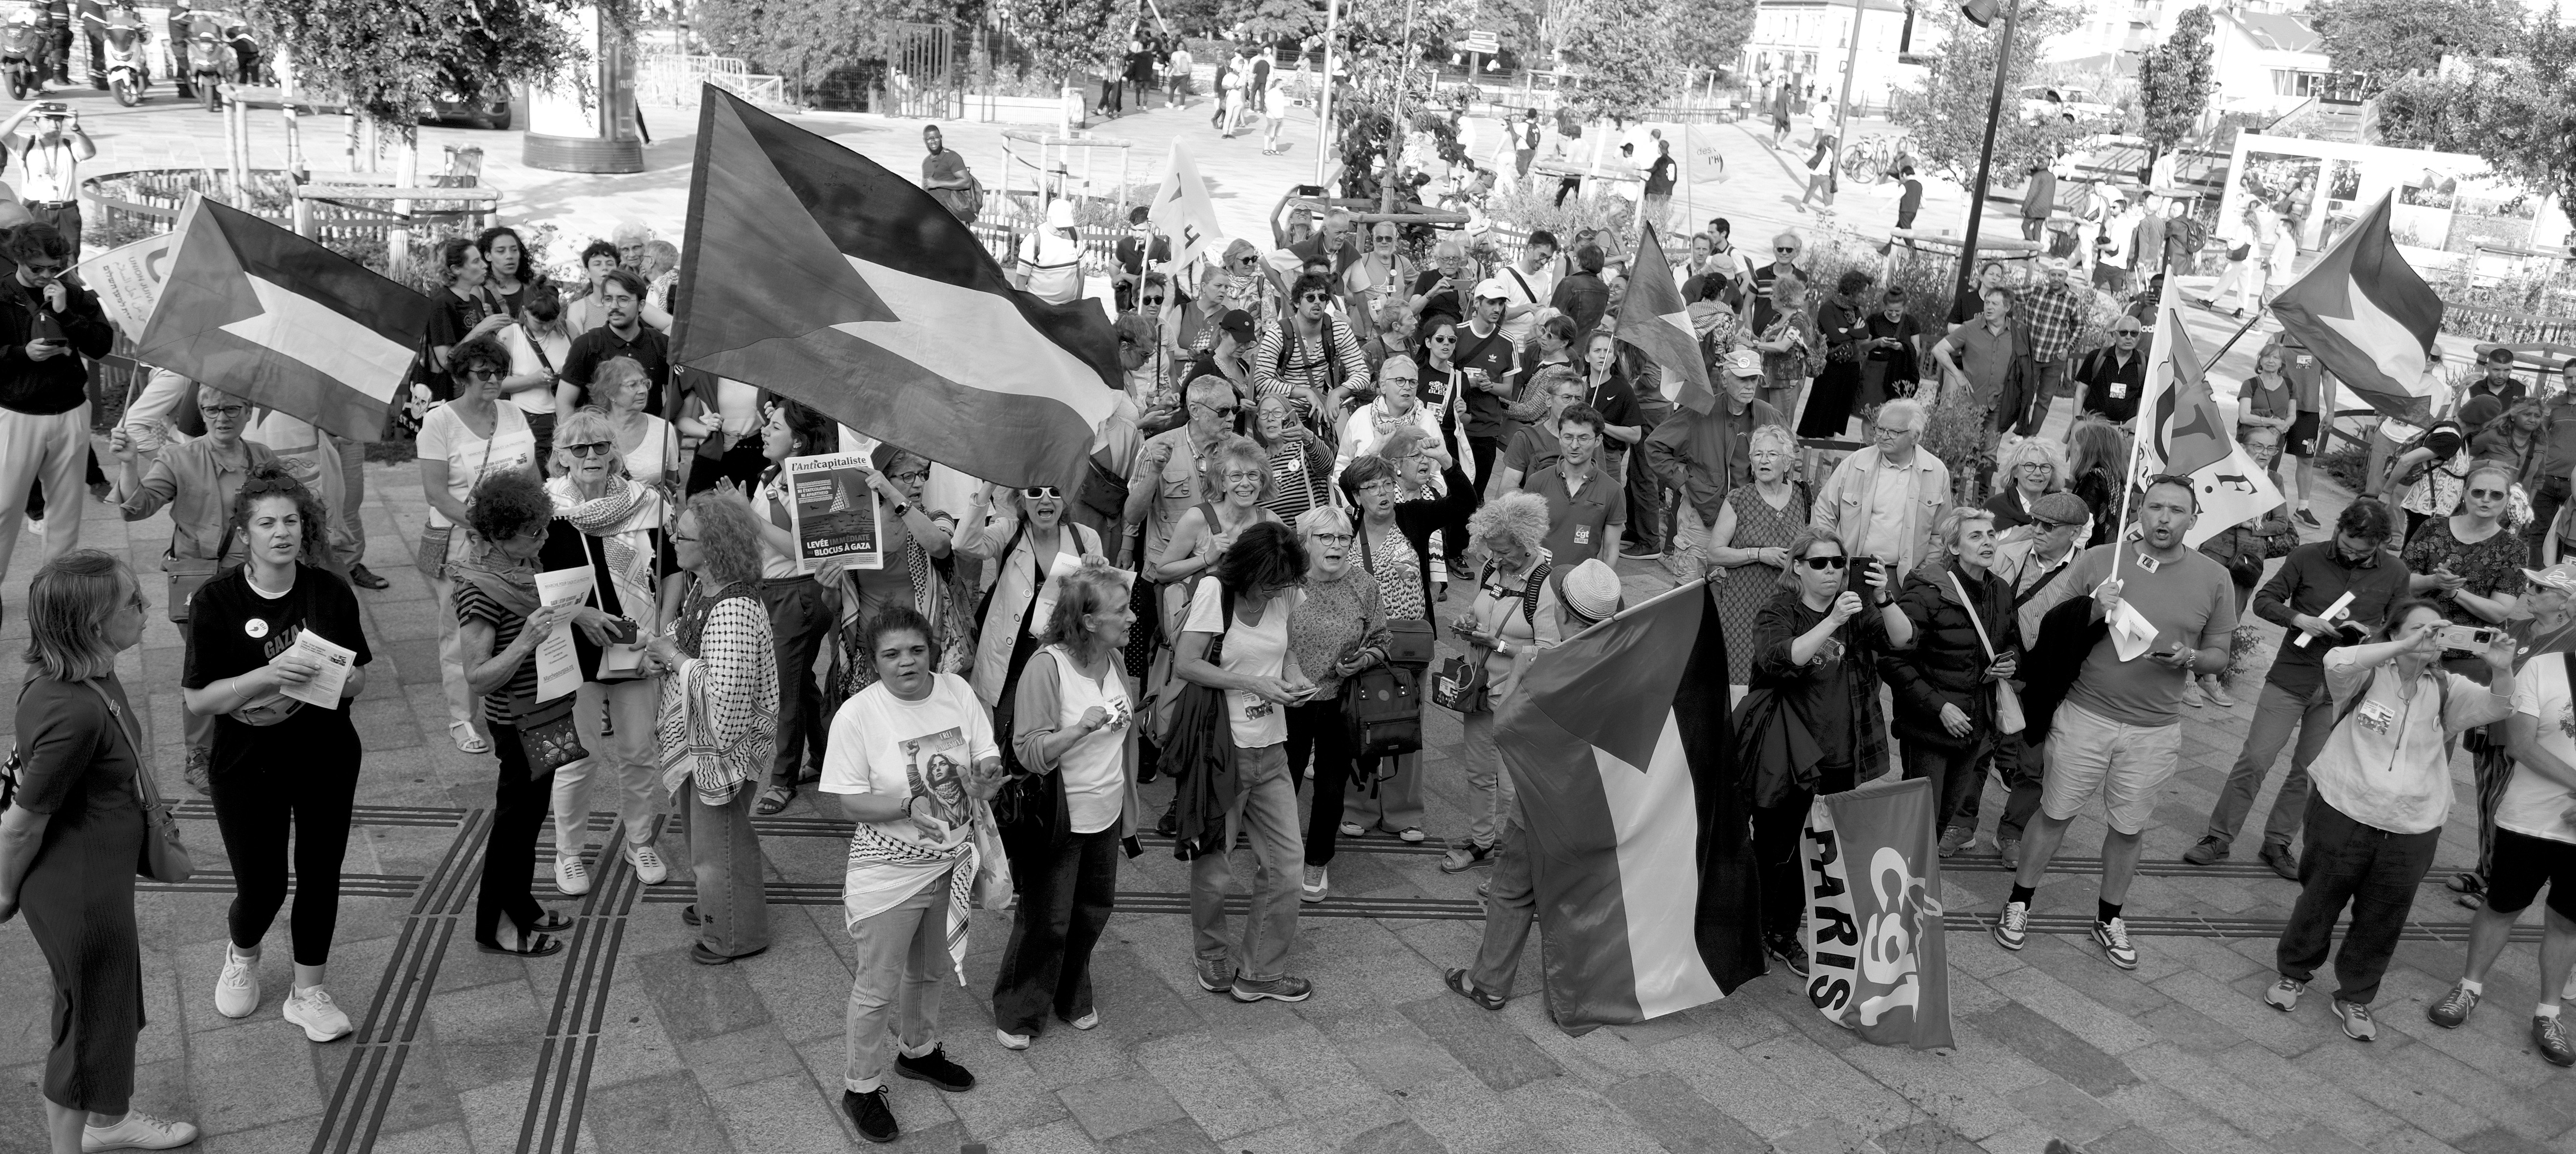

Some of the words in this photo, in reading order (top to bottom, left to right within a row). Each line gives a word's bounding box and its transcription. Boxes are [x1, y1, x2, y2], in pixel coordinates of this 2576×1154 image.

[129, 256, 145, 282] UNION
[140, 282, 155, 304] JUIVE
[791, 456, 867, 471] l'Anticapitaliste
[807, 538, 829, 549] LEVÉE
[830, 534, 870, 546] IMMÉDIATE
[1576, 531, 1590, 539] cgt
[814, 545, 844, 556] BLOCUS
[844, 542, 850, 552] À
[850, 542, 871, 550] GAZA
[264, 624, 300, 659] GAZA
[938, 730, 954, 741] FREE
[935, 738, 965, 752] PALESTINE
[1804, 826, 1858, 1011] PARIS
[1860, 847, 1920, 1026] cgt
